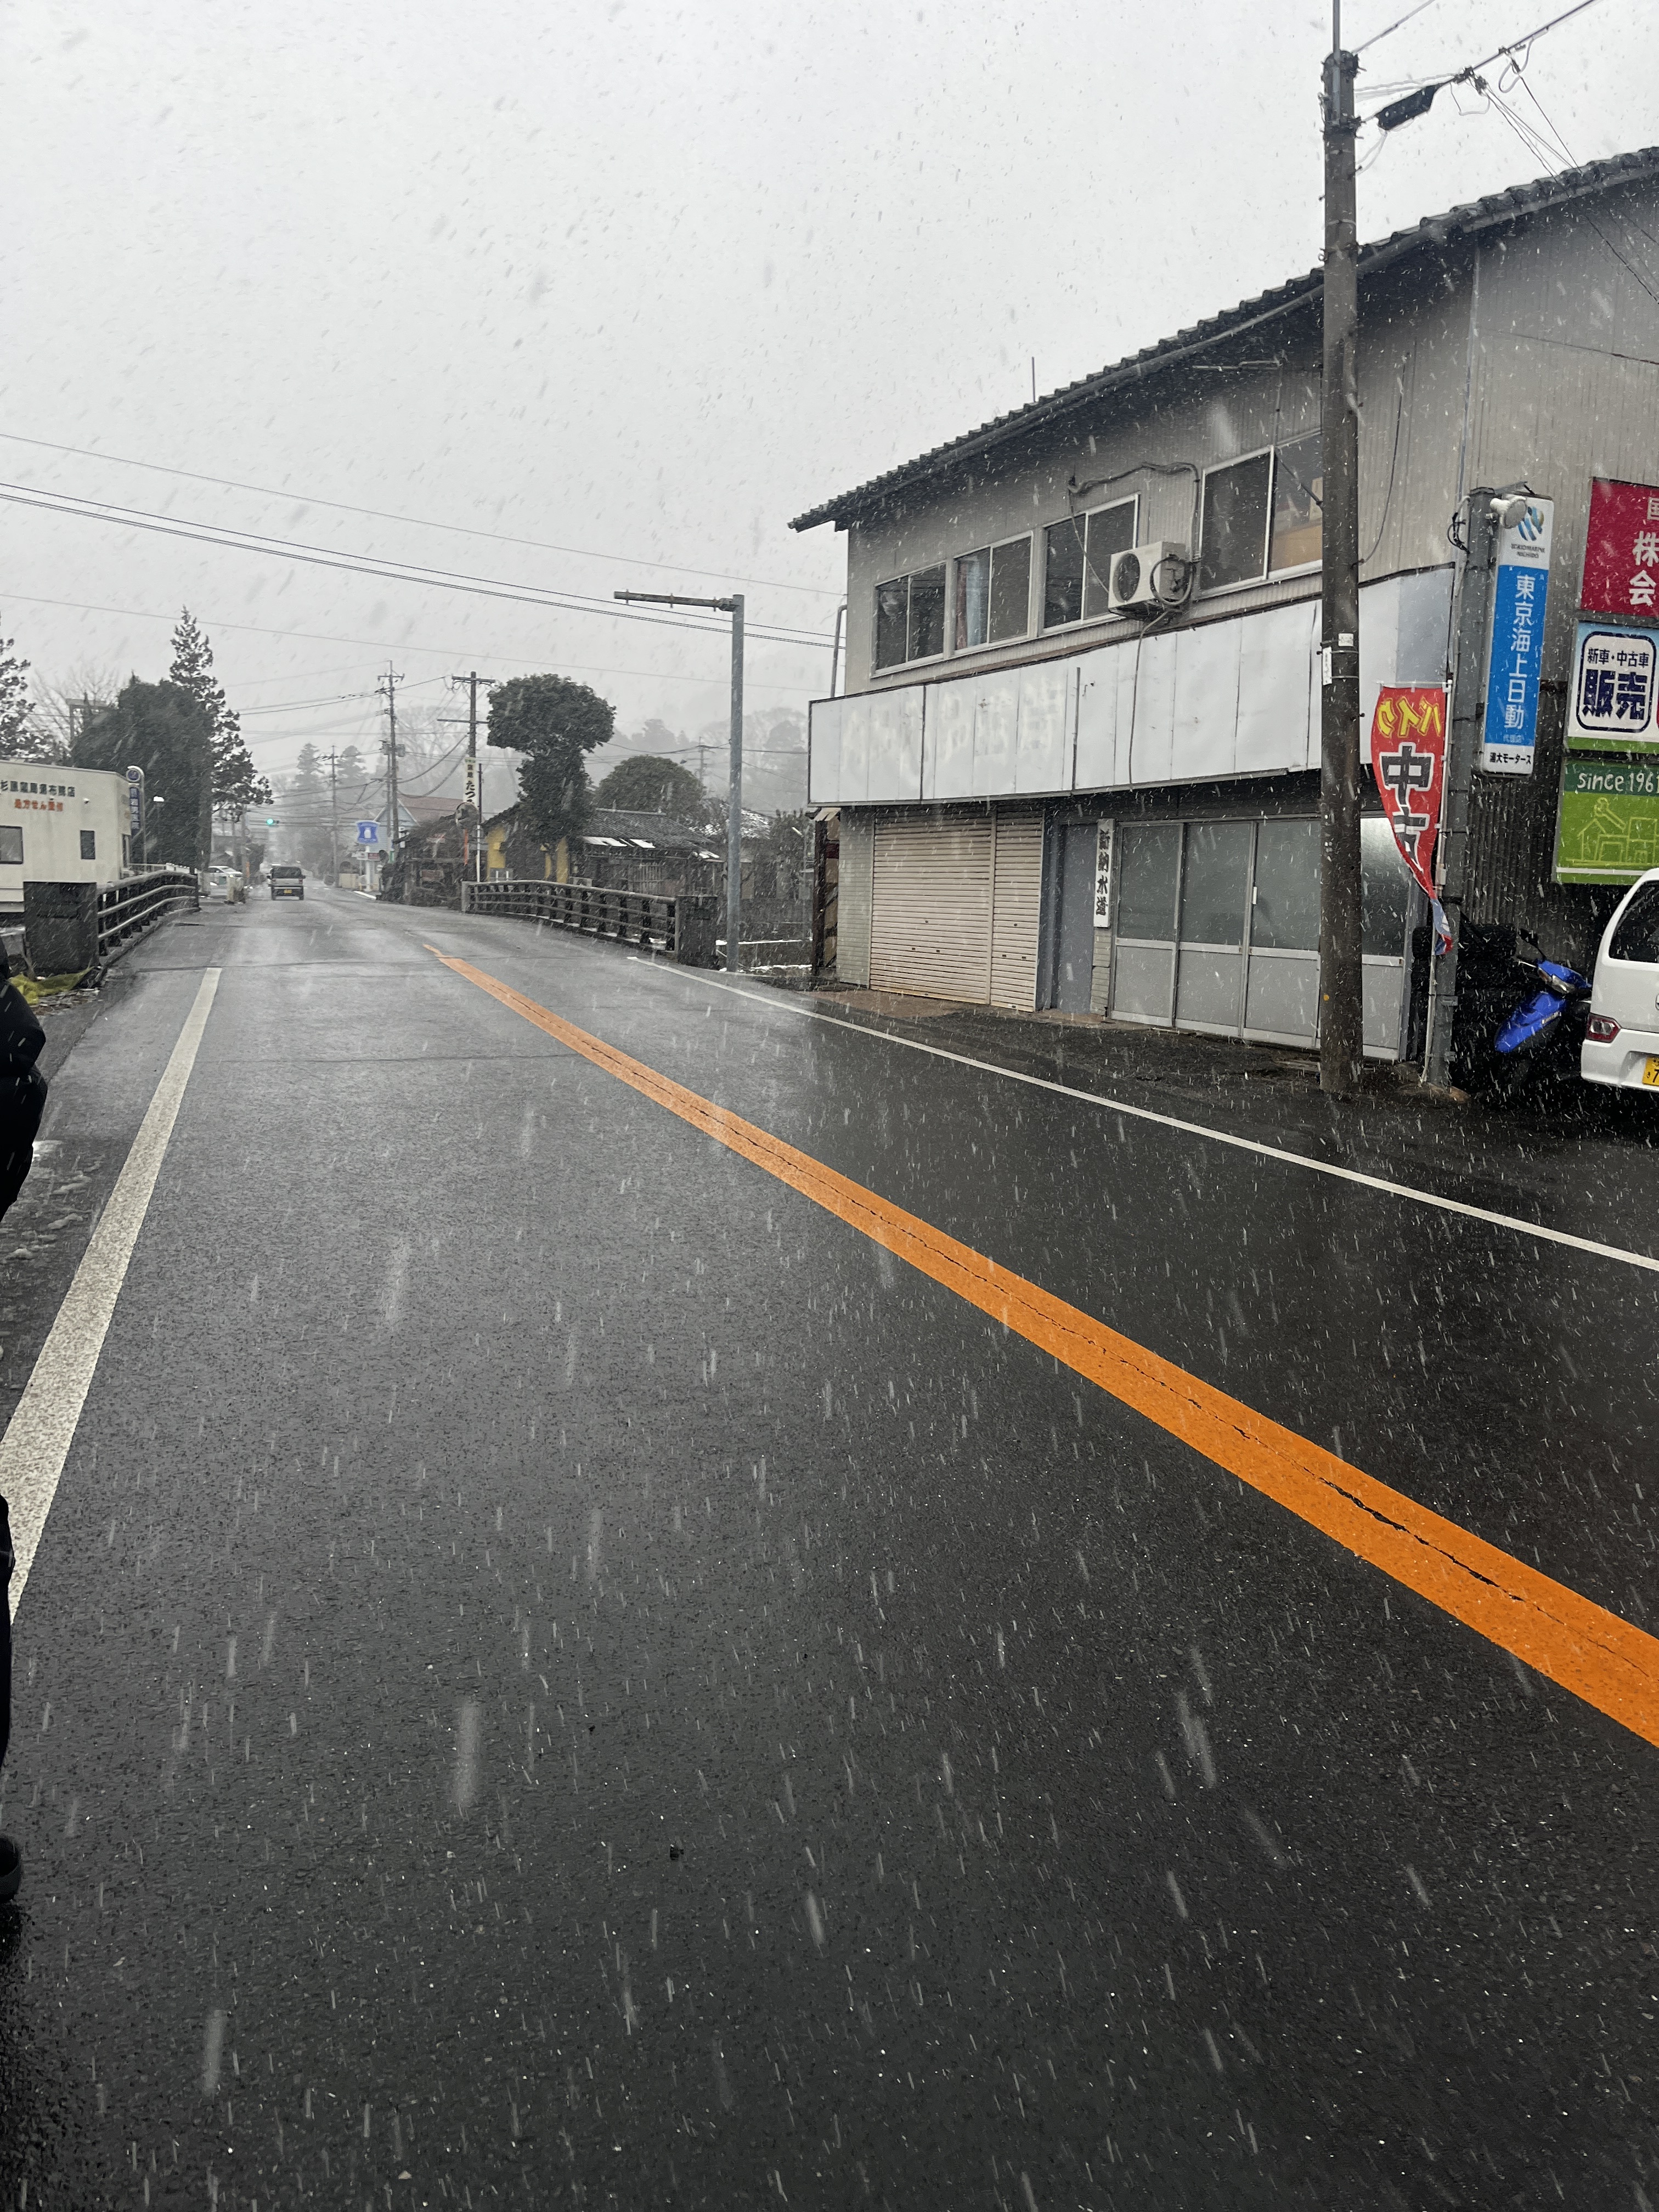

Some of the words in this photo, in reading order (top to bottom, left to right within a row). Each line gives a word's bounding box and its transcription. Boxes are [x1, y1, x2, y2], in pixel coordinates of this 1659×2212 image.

[1504, 574, 1535, 730] 東京海上日動
[1587, 648, 1650, 668] 新車・中古車
[1582, 669, 1647, 720] 販売
[1577, 772, 1624, 792] since
